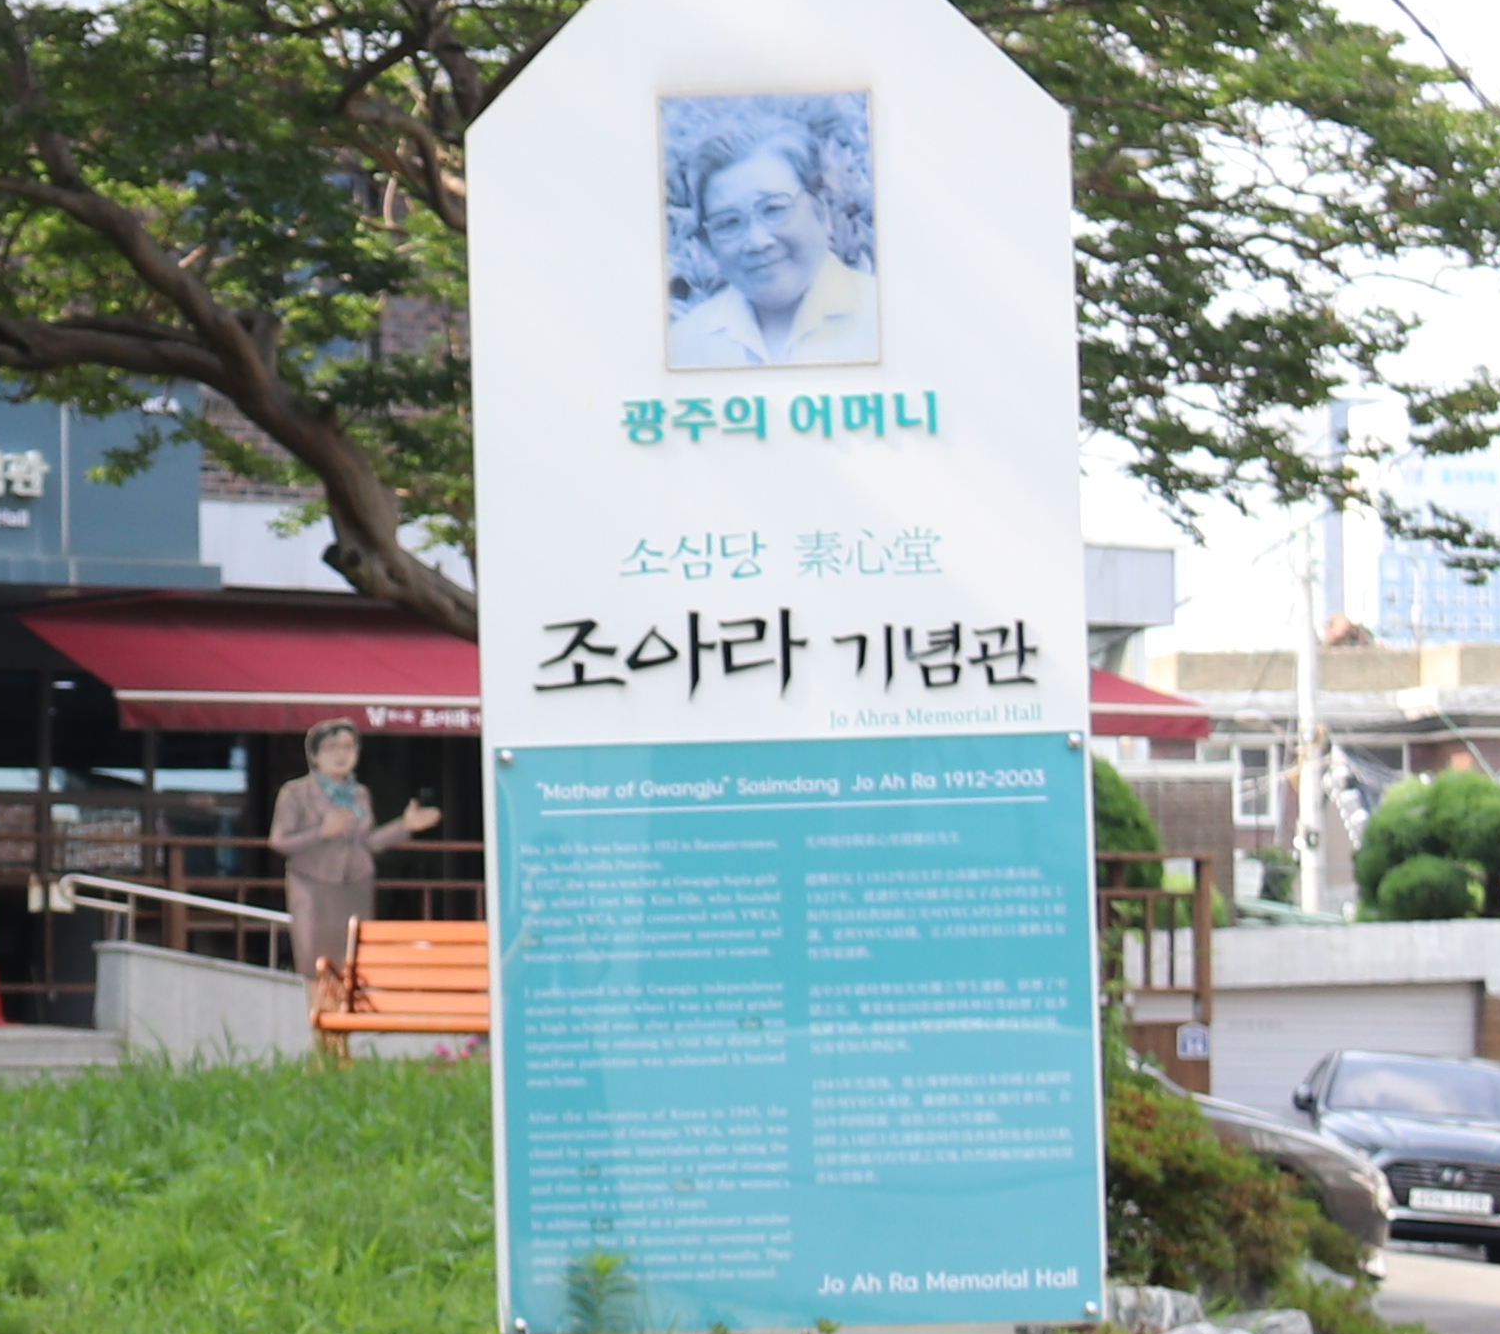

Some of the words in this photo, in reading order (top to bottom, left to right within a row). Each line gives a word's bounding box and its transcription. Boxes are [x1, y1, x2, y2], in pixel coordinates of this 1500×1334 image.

[619, 396, 767, 445] 광주의
[790, 390, 939, 439] 어머니
[619, 529, 768, 580] 소심당
[796, 528, 943, 578] 素心堂
[534, 608, 809, 697] 조아라
[834, 618, 1040, 689] 기념관
[829, 709, 848, 731] Jo
[853, 707, 901, 729] Ahra
[906, 704, 994, 727] Memorial
[1001, 702, 1043, 724] Hall
[615, 779, 635, 799] of
[736, 774, 840, 798] Sosimdang
[851, 773, 875, 793] Jo
[879, 772, 906, 791] Ah
[911, 770, 937, 790] Ra
[818, 1273, 847, 1297] Jo
[852, 1271, 882, 1293] Ah
[889, 1271, 920, 1292] Ra
[926, 1268, 1030, 1292] Memorial
[1035, 1266, 1078, 1289] Hall
